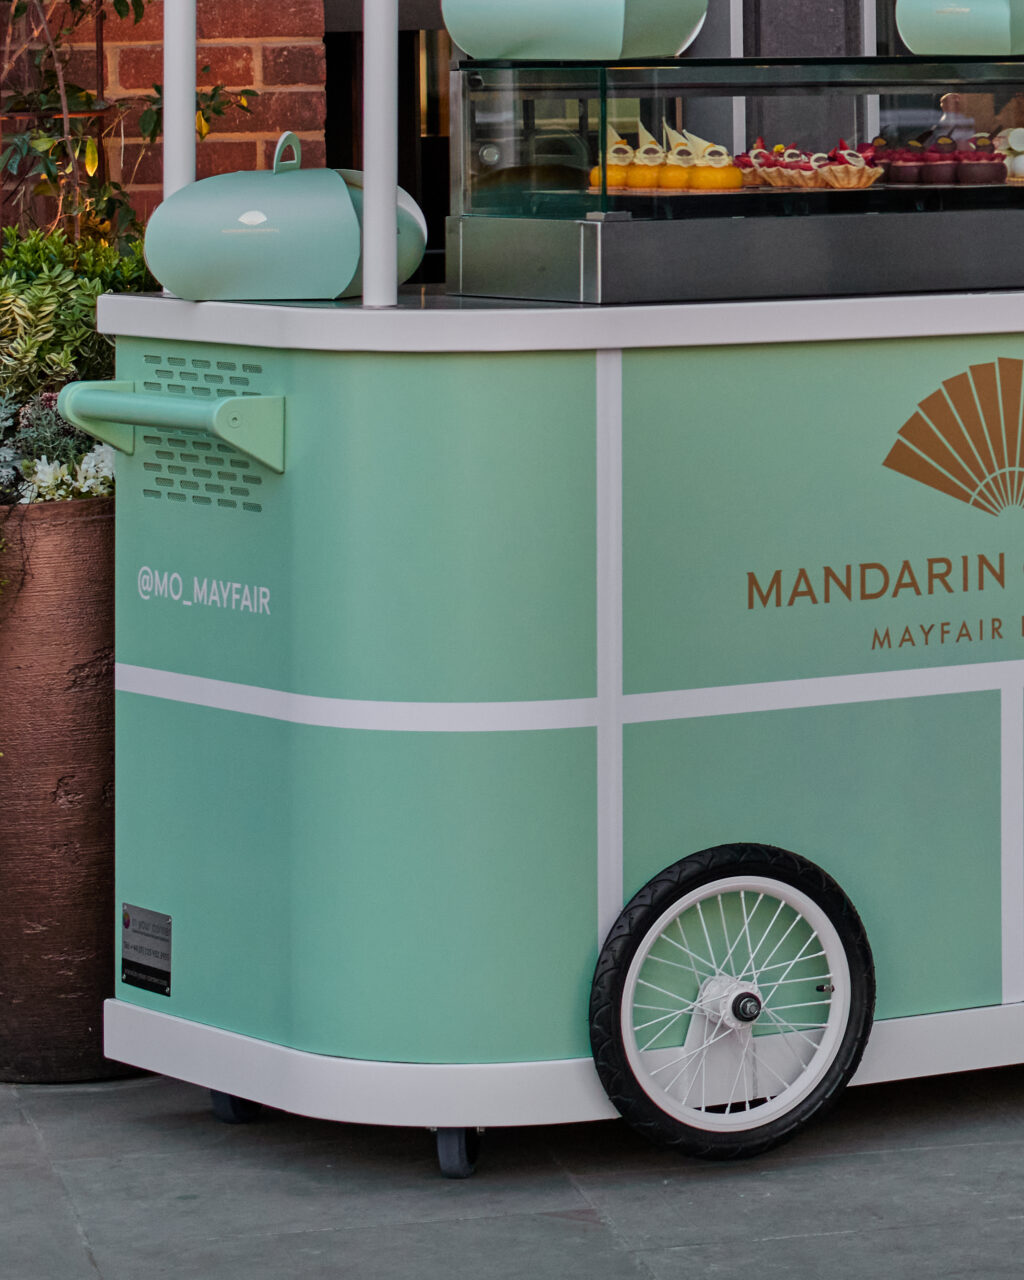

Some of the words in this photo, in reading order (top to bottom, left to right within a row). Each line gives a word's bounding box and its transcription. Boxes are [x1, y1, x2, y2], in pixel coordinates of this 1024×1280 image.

[137, 565, 272, 615] @MO_MAYFAIR
[746, 551, 1006, 610] MANDARIN
[871, 617, 1004, 651] MAYFAIR
